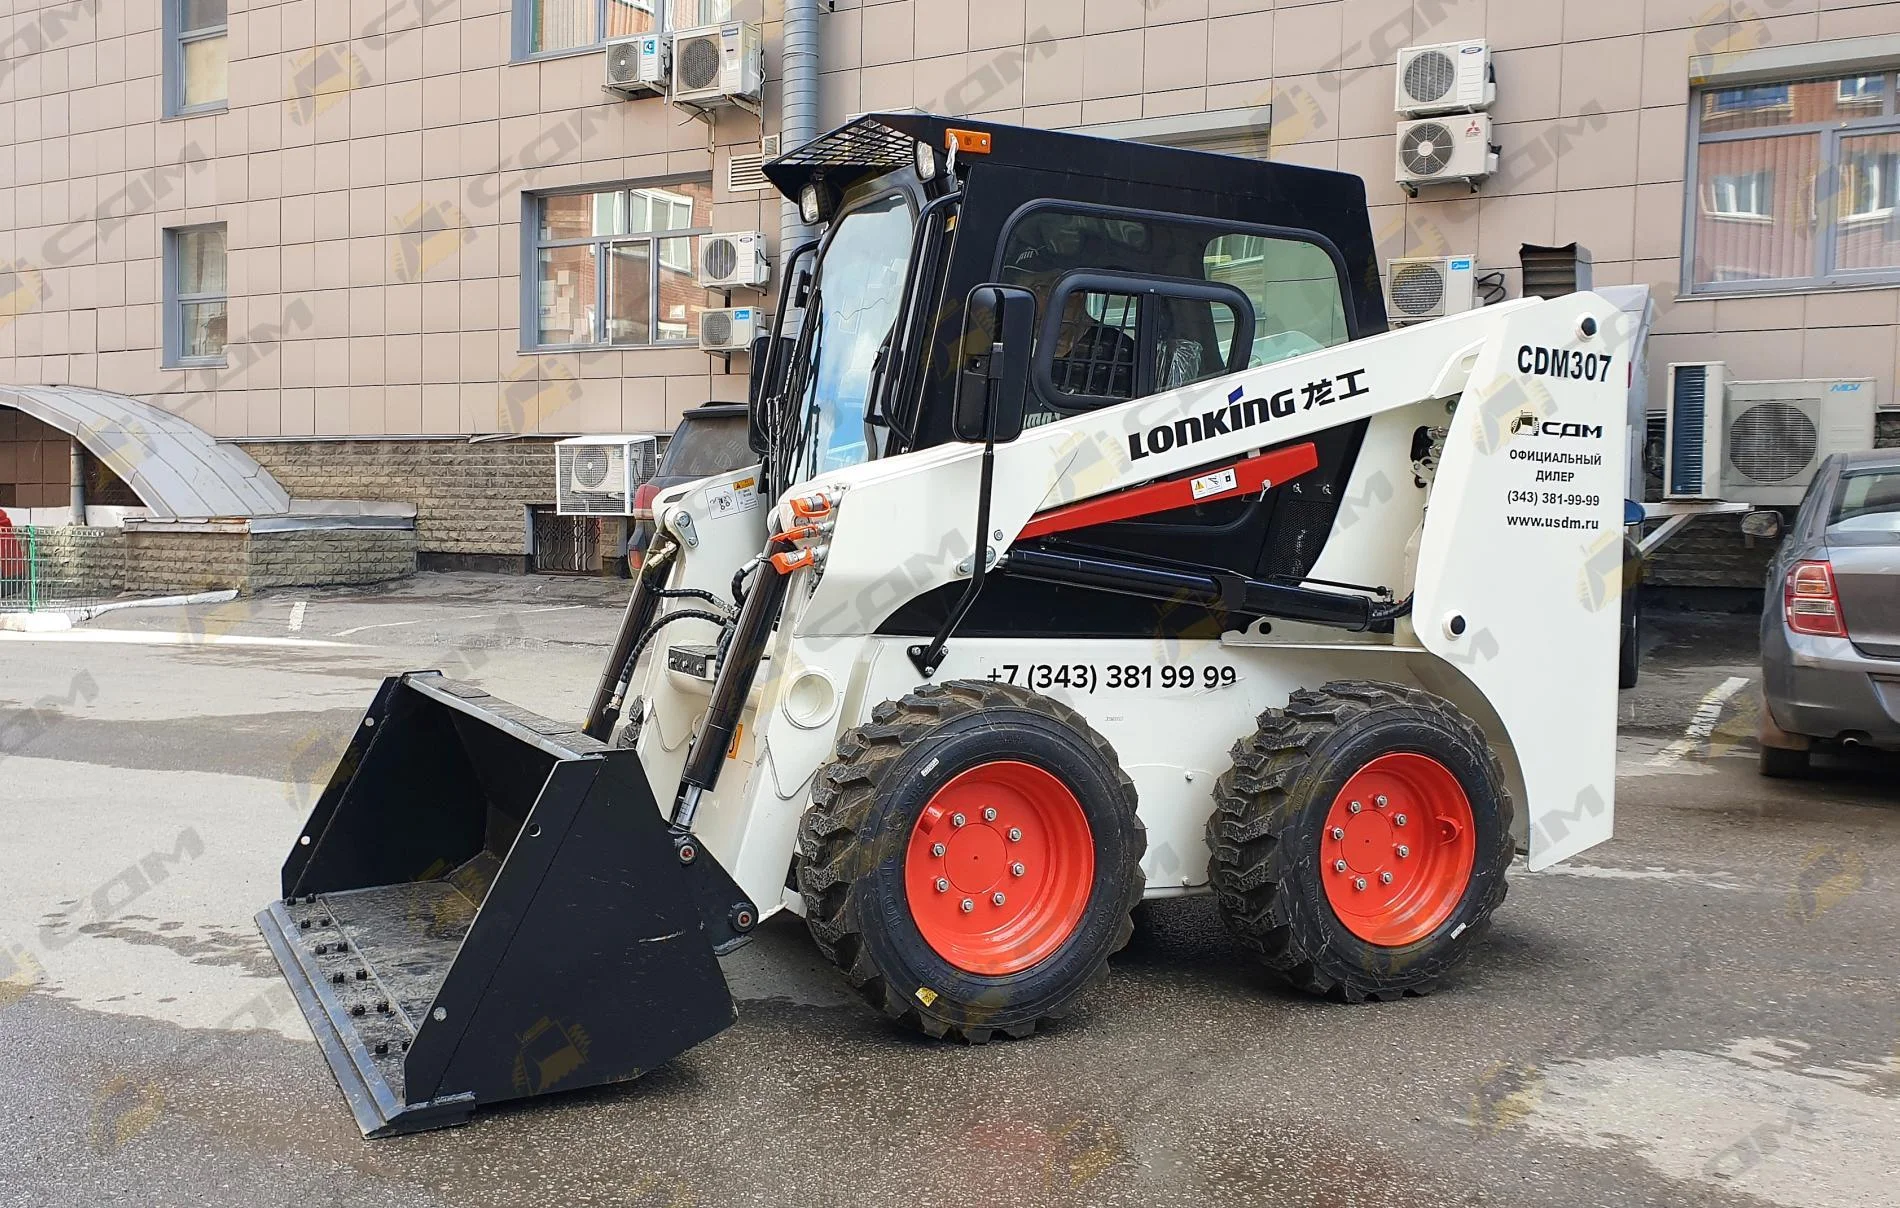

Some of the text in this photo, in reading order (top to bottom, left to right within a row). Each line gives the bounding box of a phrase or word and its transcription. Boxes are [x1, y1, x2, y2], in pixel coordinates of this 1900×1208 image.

[1517, 345, 1612, 382] CDM307
[1300, 368, 1370, 410] 龙工
[1509, 449, 1602, 466] ОФИЦИАЛЬНЫЙ
[1535, 470, 1575, 483] ДИЛЕР
[1507, 490, 1600, 506] (343) 381-99-99
[1506, 515, 1599, 530] www.usdm.ru
[987, 664, 1237, 694] +7 (343) 381 99 99
